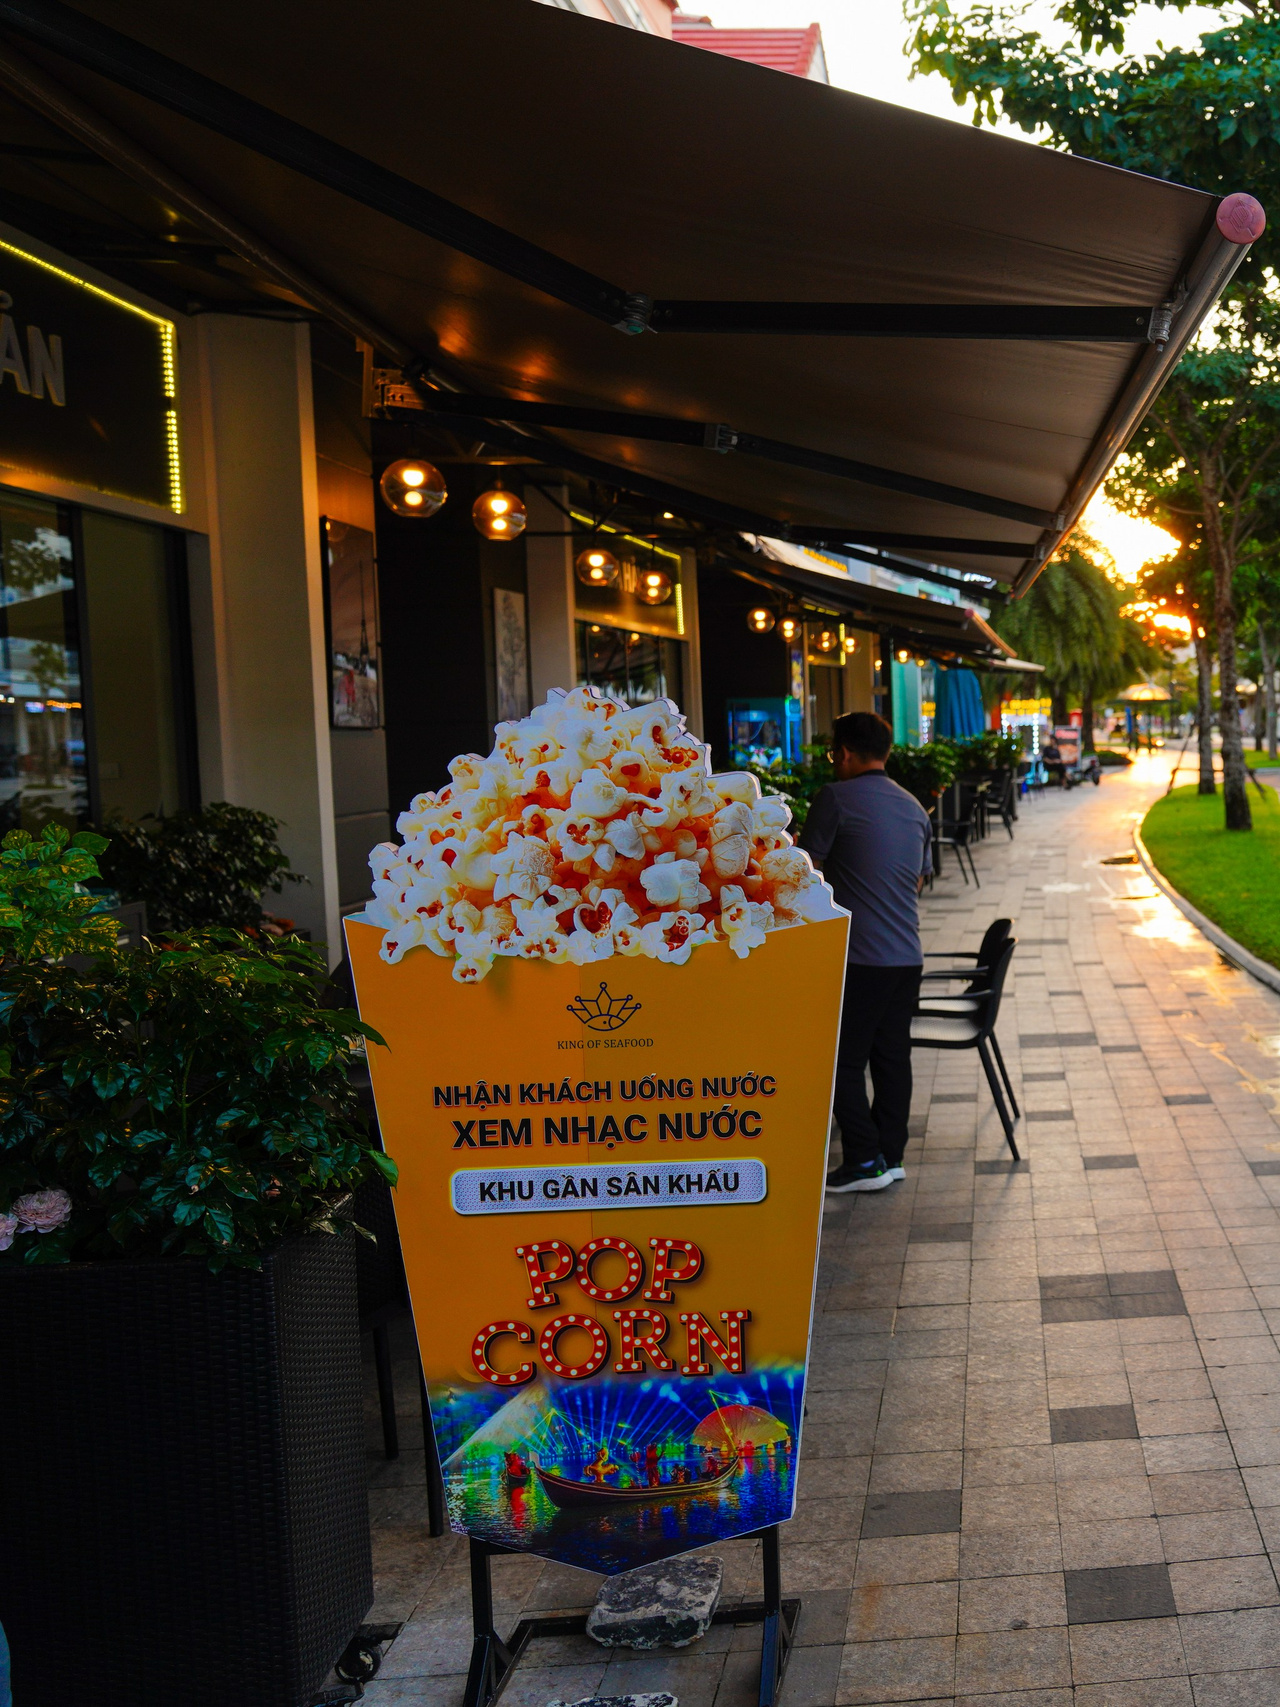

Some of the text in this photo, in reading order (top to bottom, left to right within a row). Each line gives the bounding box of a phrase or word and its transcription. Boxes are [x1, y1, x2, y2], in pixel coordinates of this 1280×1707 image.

[557, 1038, 654, 1050] KING OF SEAFOOD
[433, 1071, 777, 1109] NHẬN KHÁCH UỐNG NƯỚC
[452, 1104, 763, 1149] XEM NHẠC NƯỚC
[479, 1168, 740, 1202] KHU GẦN SÂN KHẤU
[514, 1236, 704, 1309] POP
[471, 1308, 751, 1387] CORN
